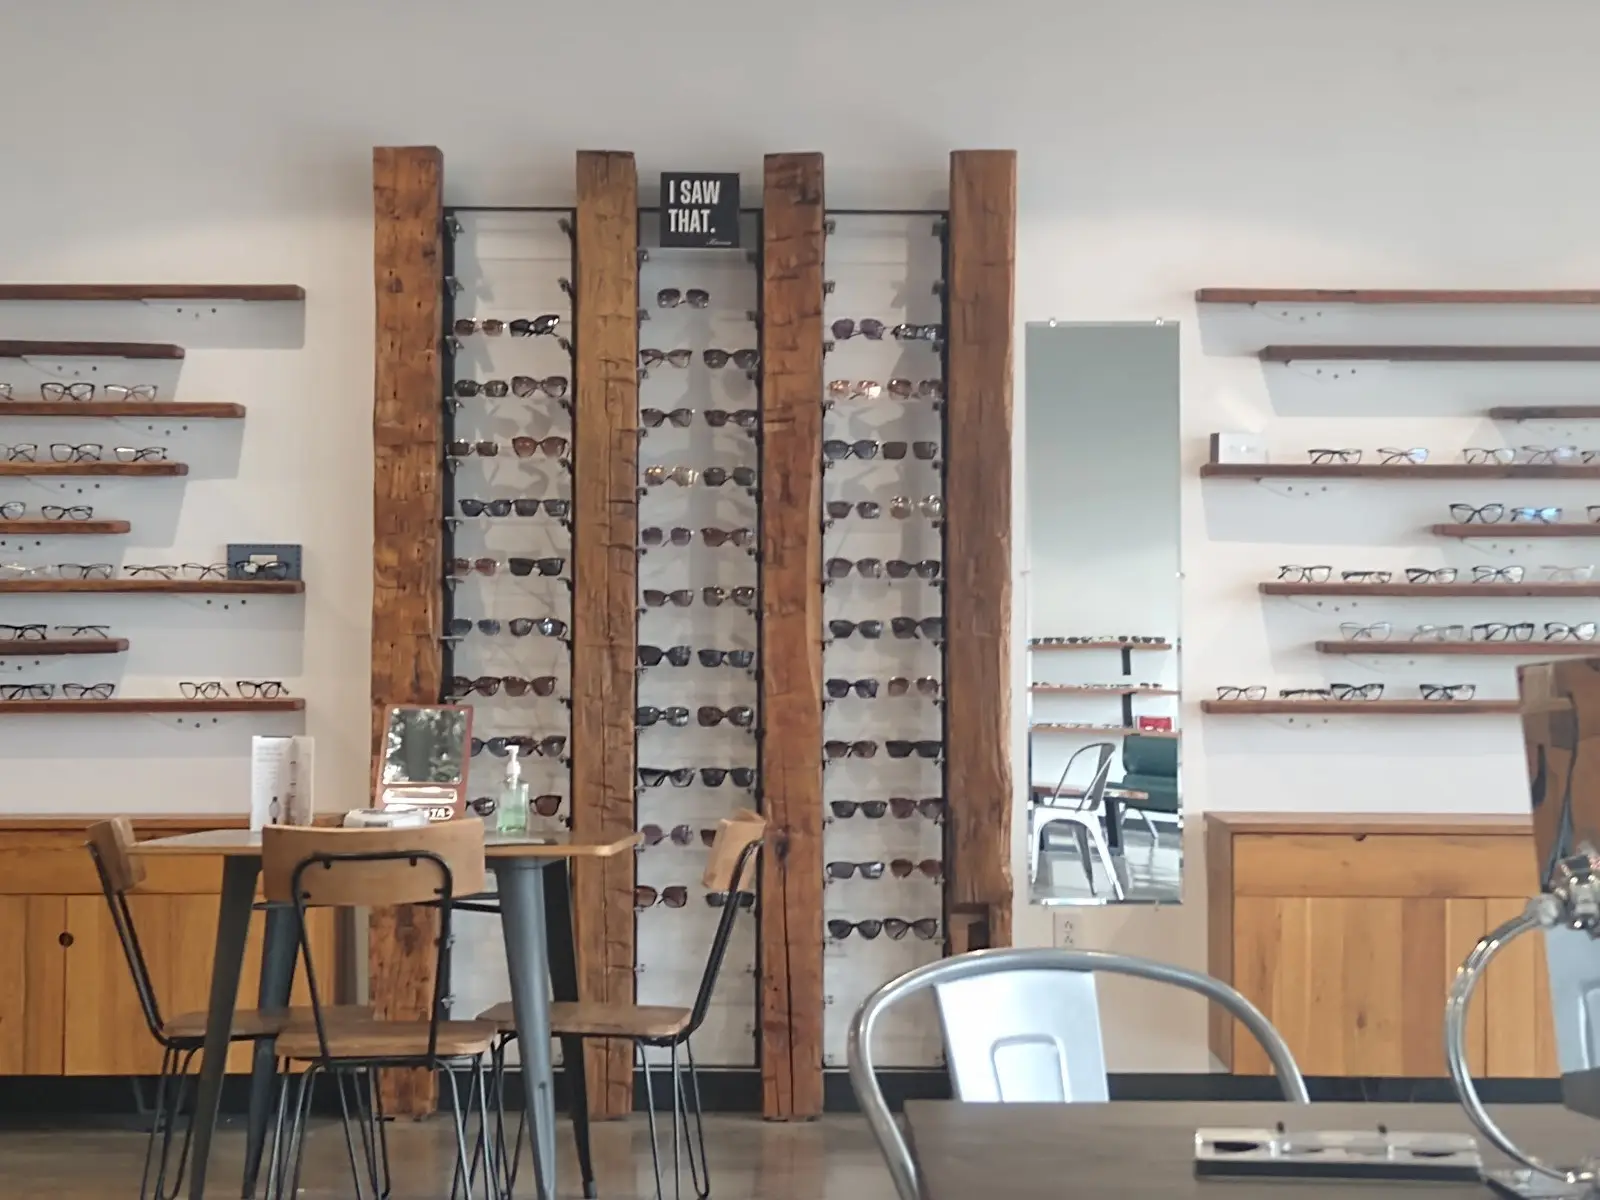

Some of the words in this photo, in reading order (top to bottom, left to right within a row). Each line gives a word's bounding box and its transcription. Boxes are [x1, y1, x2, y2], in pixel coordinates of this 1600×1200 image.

[669, 180, 675, 204] I
[680, 180, 720, 205] SAW
[668, 209, 716, 233] THAT.
